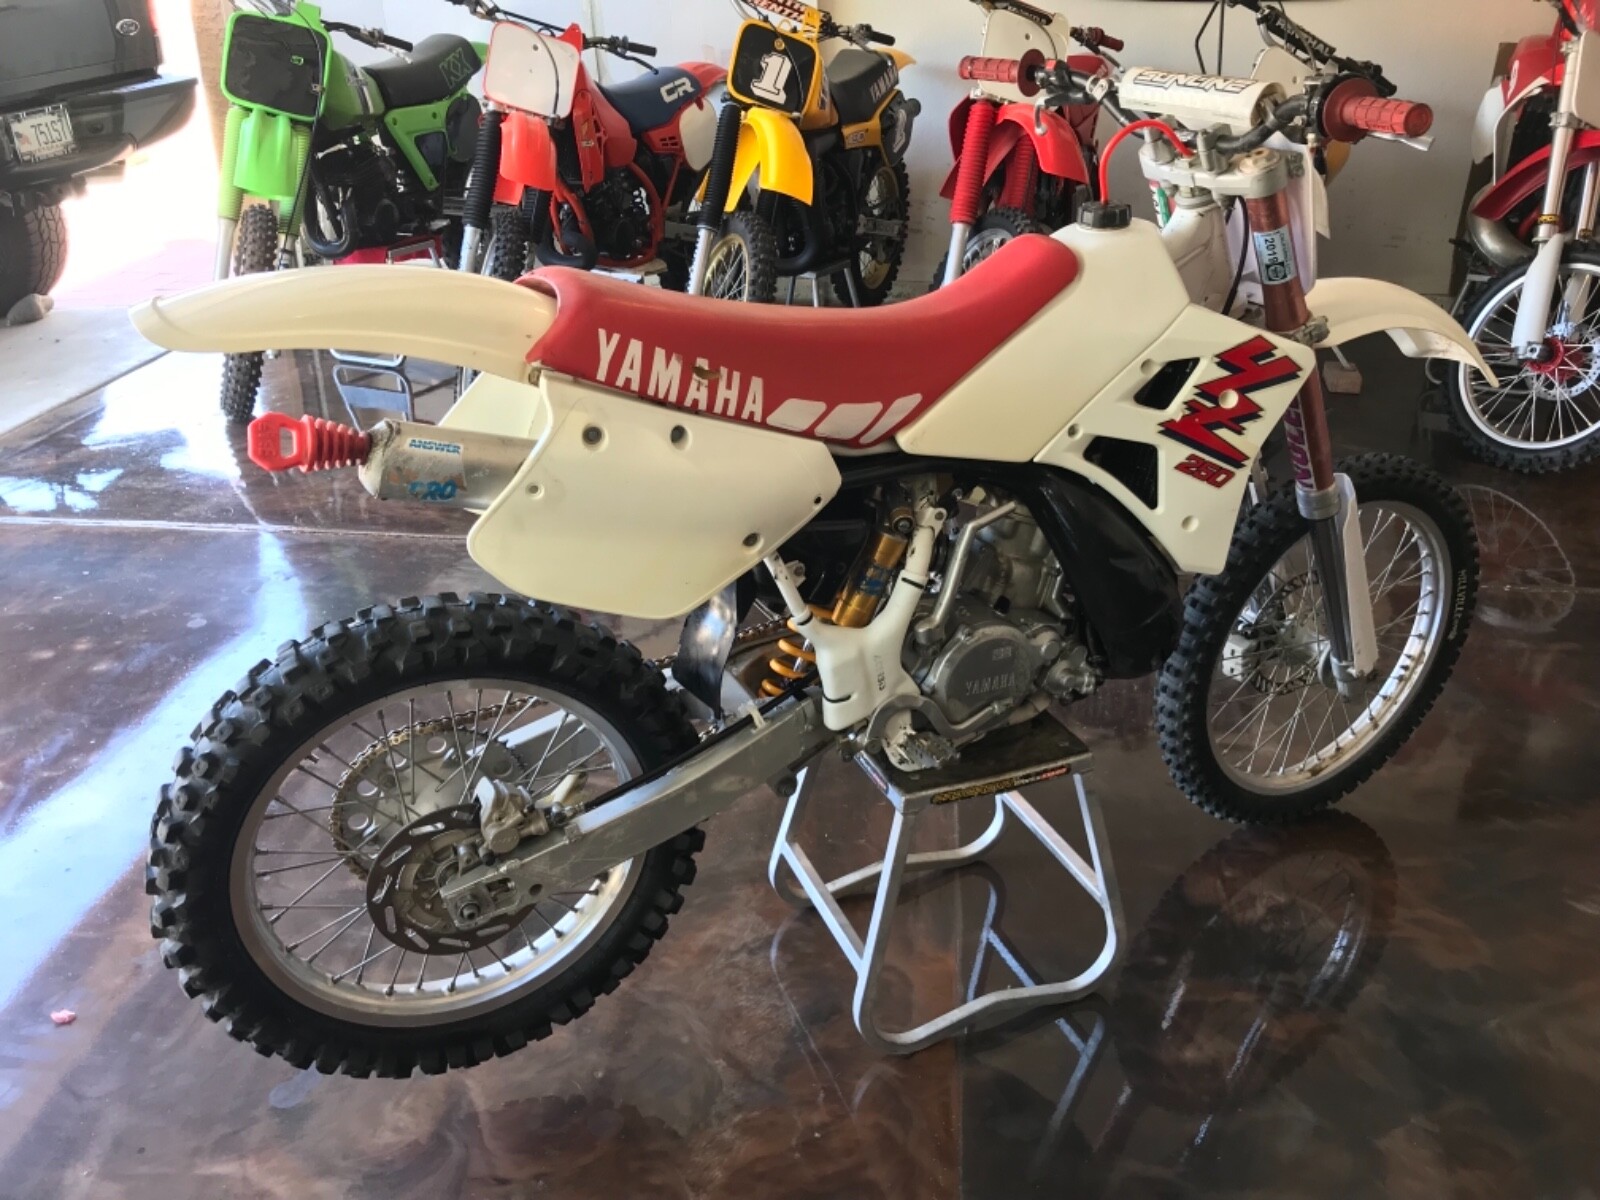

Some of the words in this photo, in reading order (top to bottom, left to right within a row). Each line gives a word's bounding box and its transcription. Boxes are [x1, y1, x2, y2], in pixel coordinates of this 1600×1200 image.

[439, 47, 473, 89] KX
[750, 52, 793, 105] 1
[1133, 70, 1257, 94] SUNLINE
[660, 77, 695, 103] CR
[596, 328, 765, 423] YAMAHA
[965, 672, 1016, 697] YAMAHA
